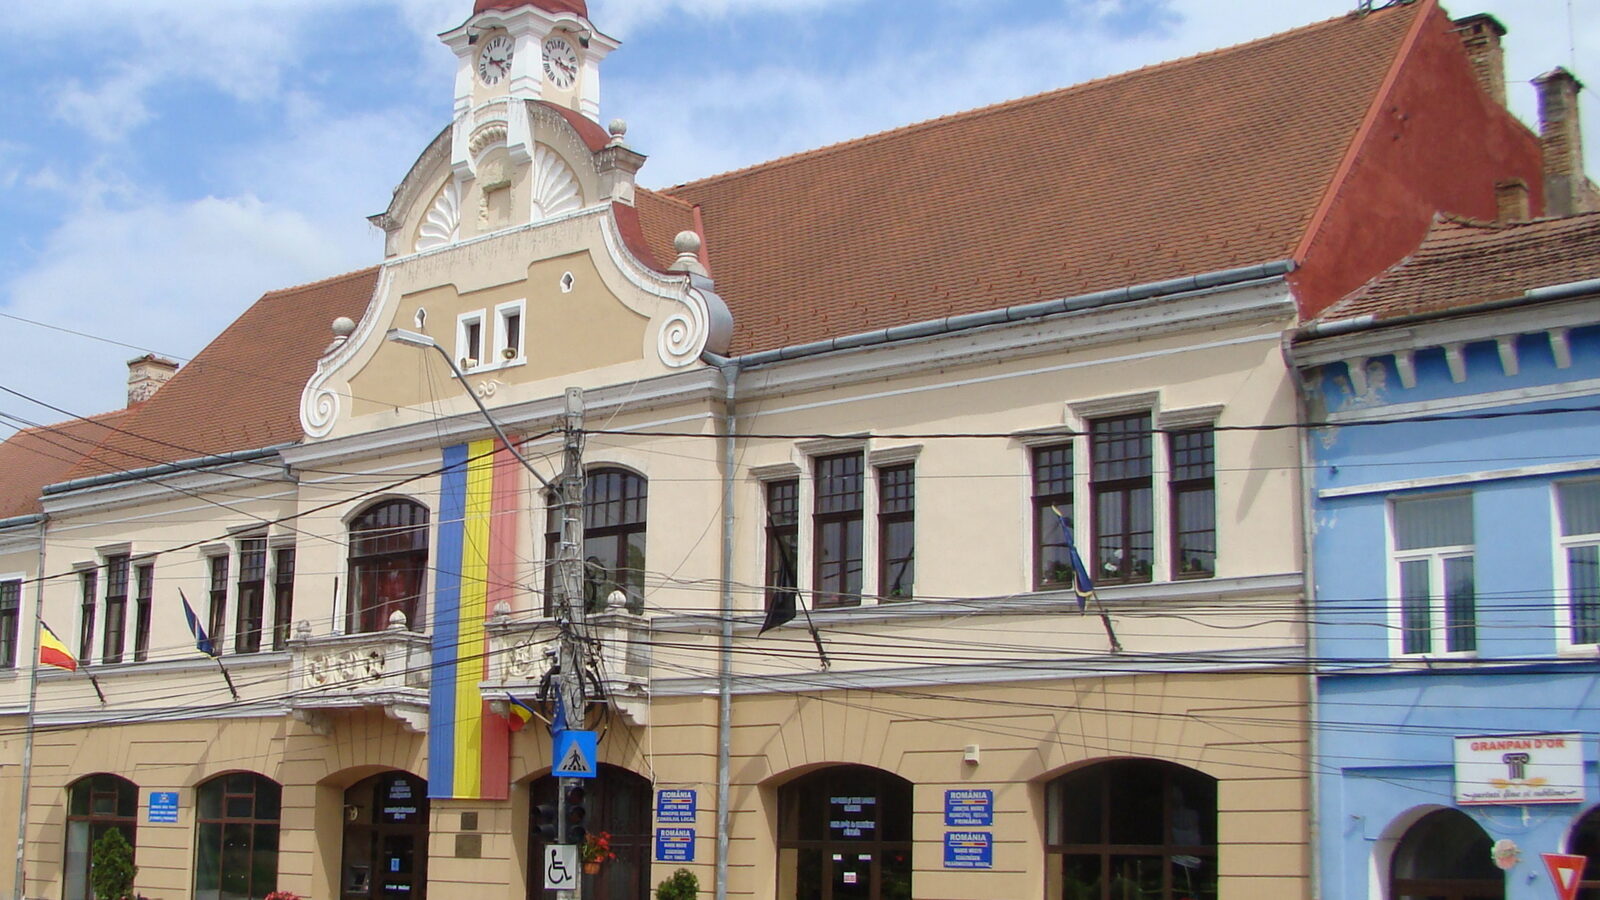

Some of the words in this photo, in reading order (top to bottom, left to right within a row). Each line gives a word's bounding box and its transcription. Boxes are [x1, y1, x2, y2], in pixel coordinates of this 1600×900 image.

[1471, 740, 1532, 751] GRANPAN
[1534, 739, 1565, 749] D'OR
[950, 790, 987, 799] ROMÂNIA
[949, 832, 987, 841] ROMÂNIA
